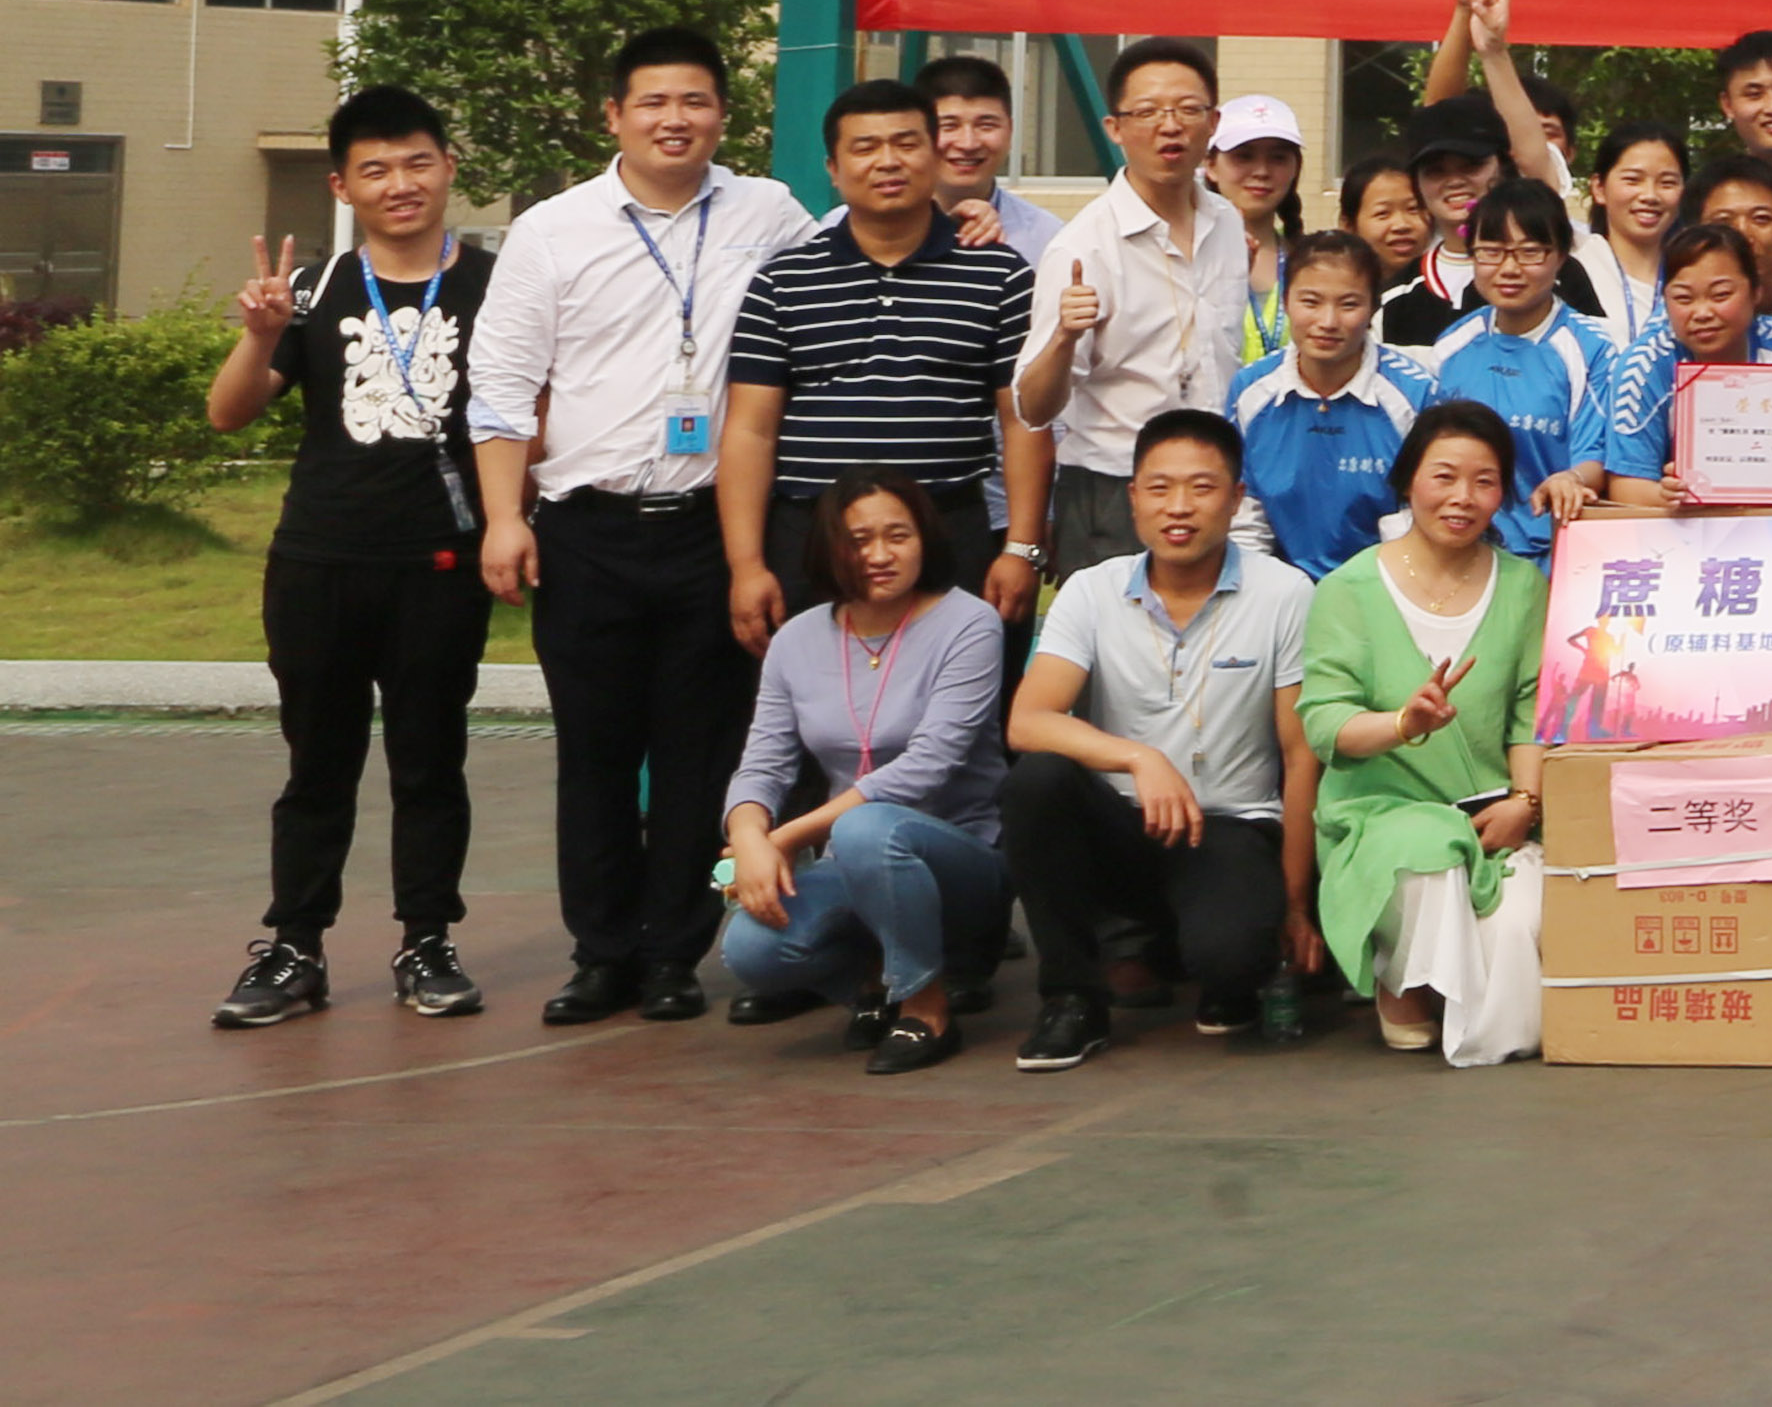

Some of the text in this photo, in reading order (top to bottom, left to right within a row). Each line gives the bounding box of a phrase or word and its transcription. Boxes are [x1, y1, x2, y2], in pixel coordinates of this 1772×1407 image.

[1648, 799, 1757, 834] 二等奖
[1614, 986, 1752, 1023] 玻璃制品
